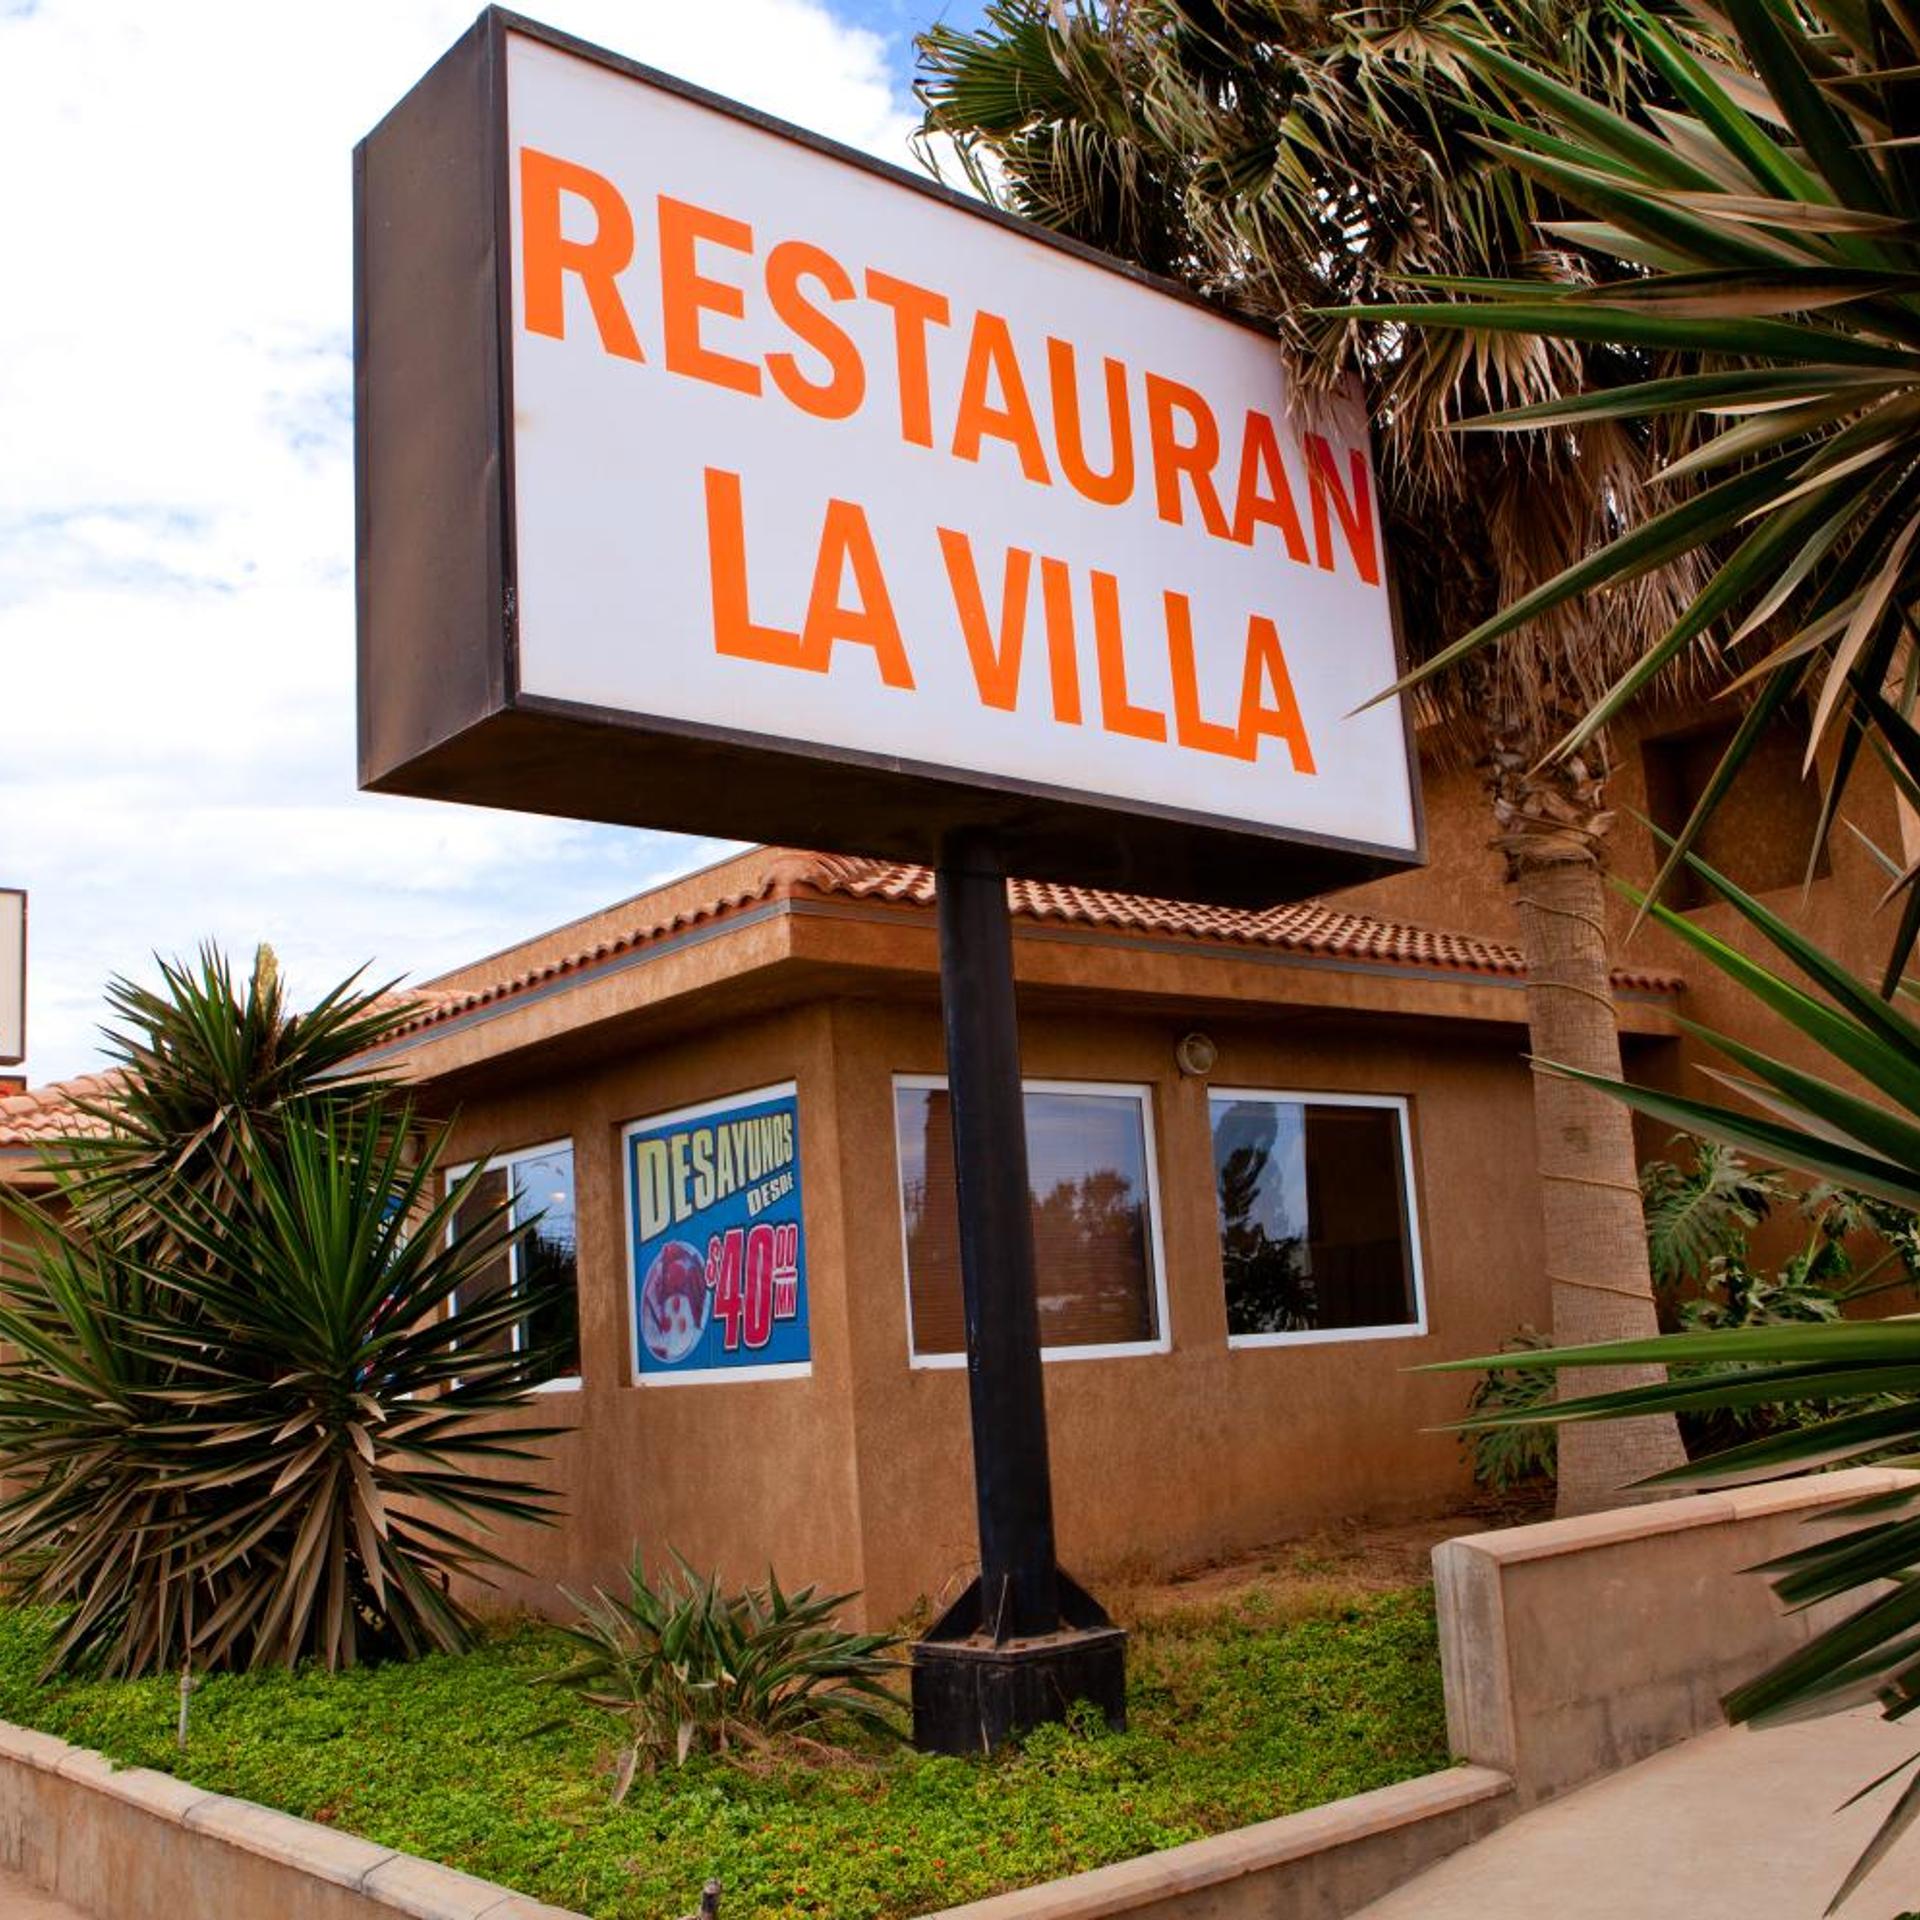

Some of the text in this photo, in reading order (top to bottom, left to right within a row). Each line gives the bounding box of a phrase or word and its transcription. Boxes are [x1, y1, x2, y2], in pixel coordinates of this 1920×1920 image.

[521, 148, 1380, 587] RESTAURAN
[705, 467, 1315, 775] LA VILLA
[636, 1113, 794, 1243] DESAYUNOS
